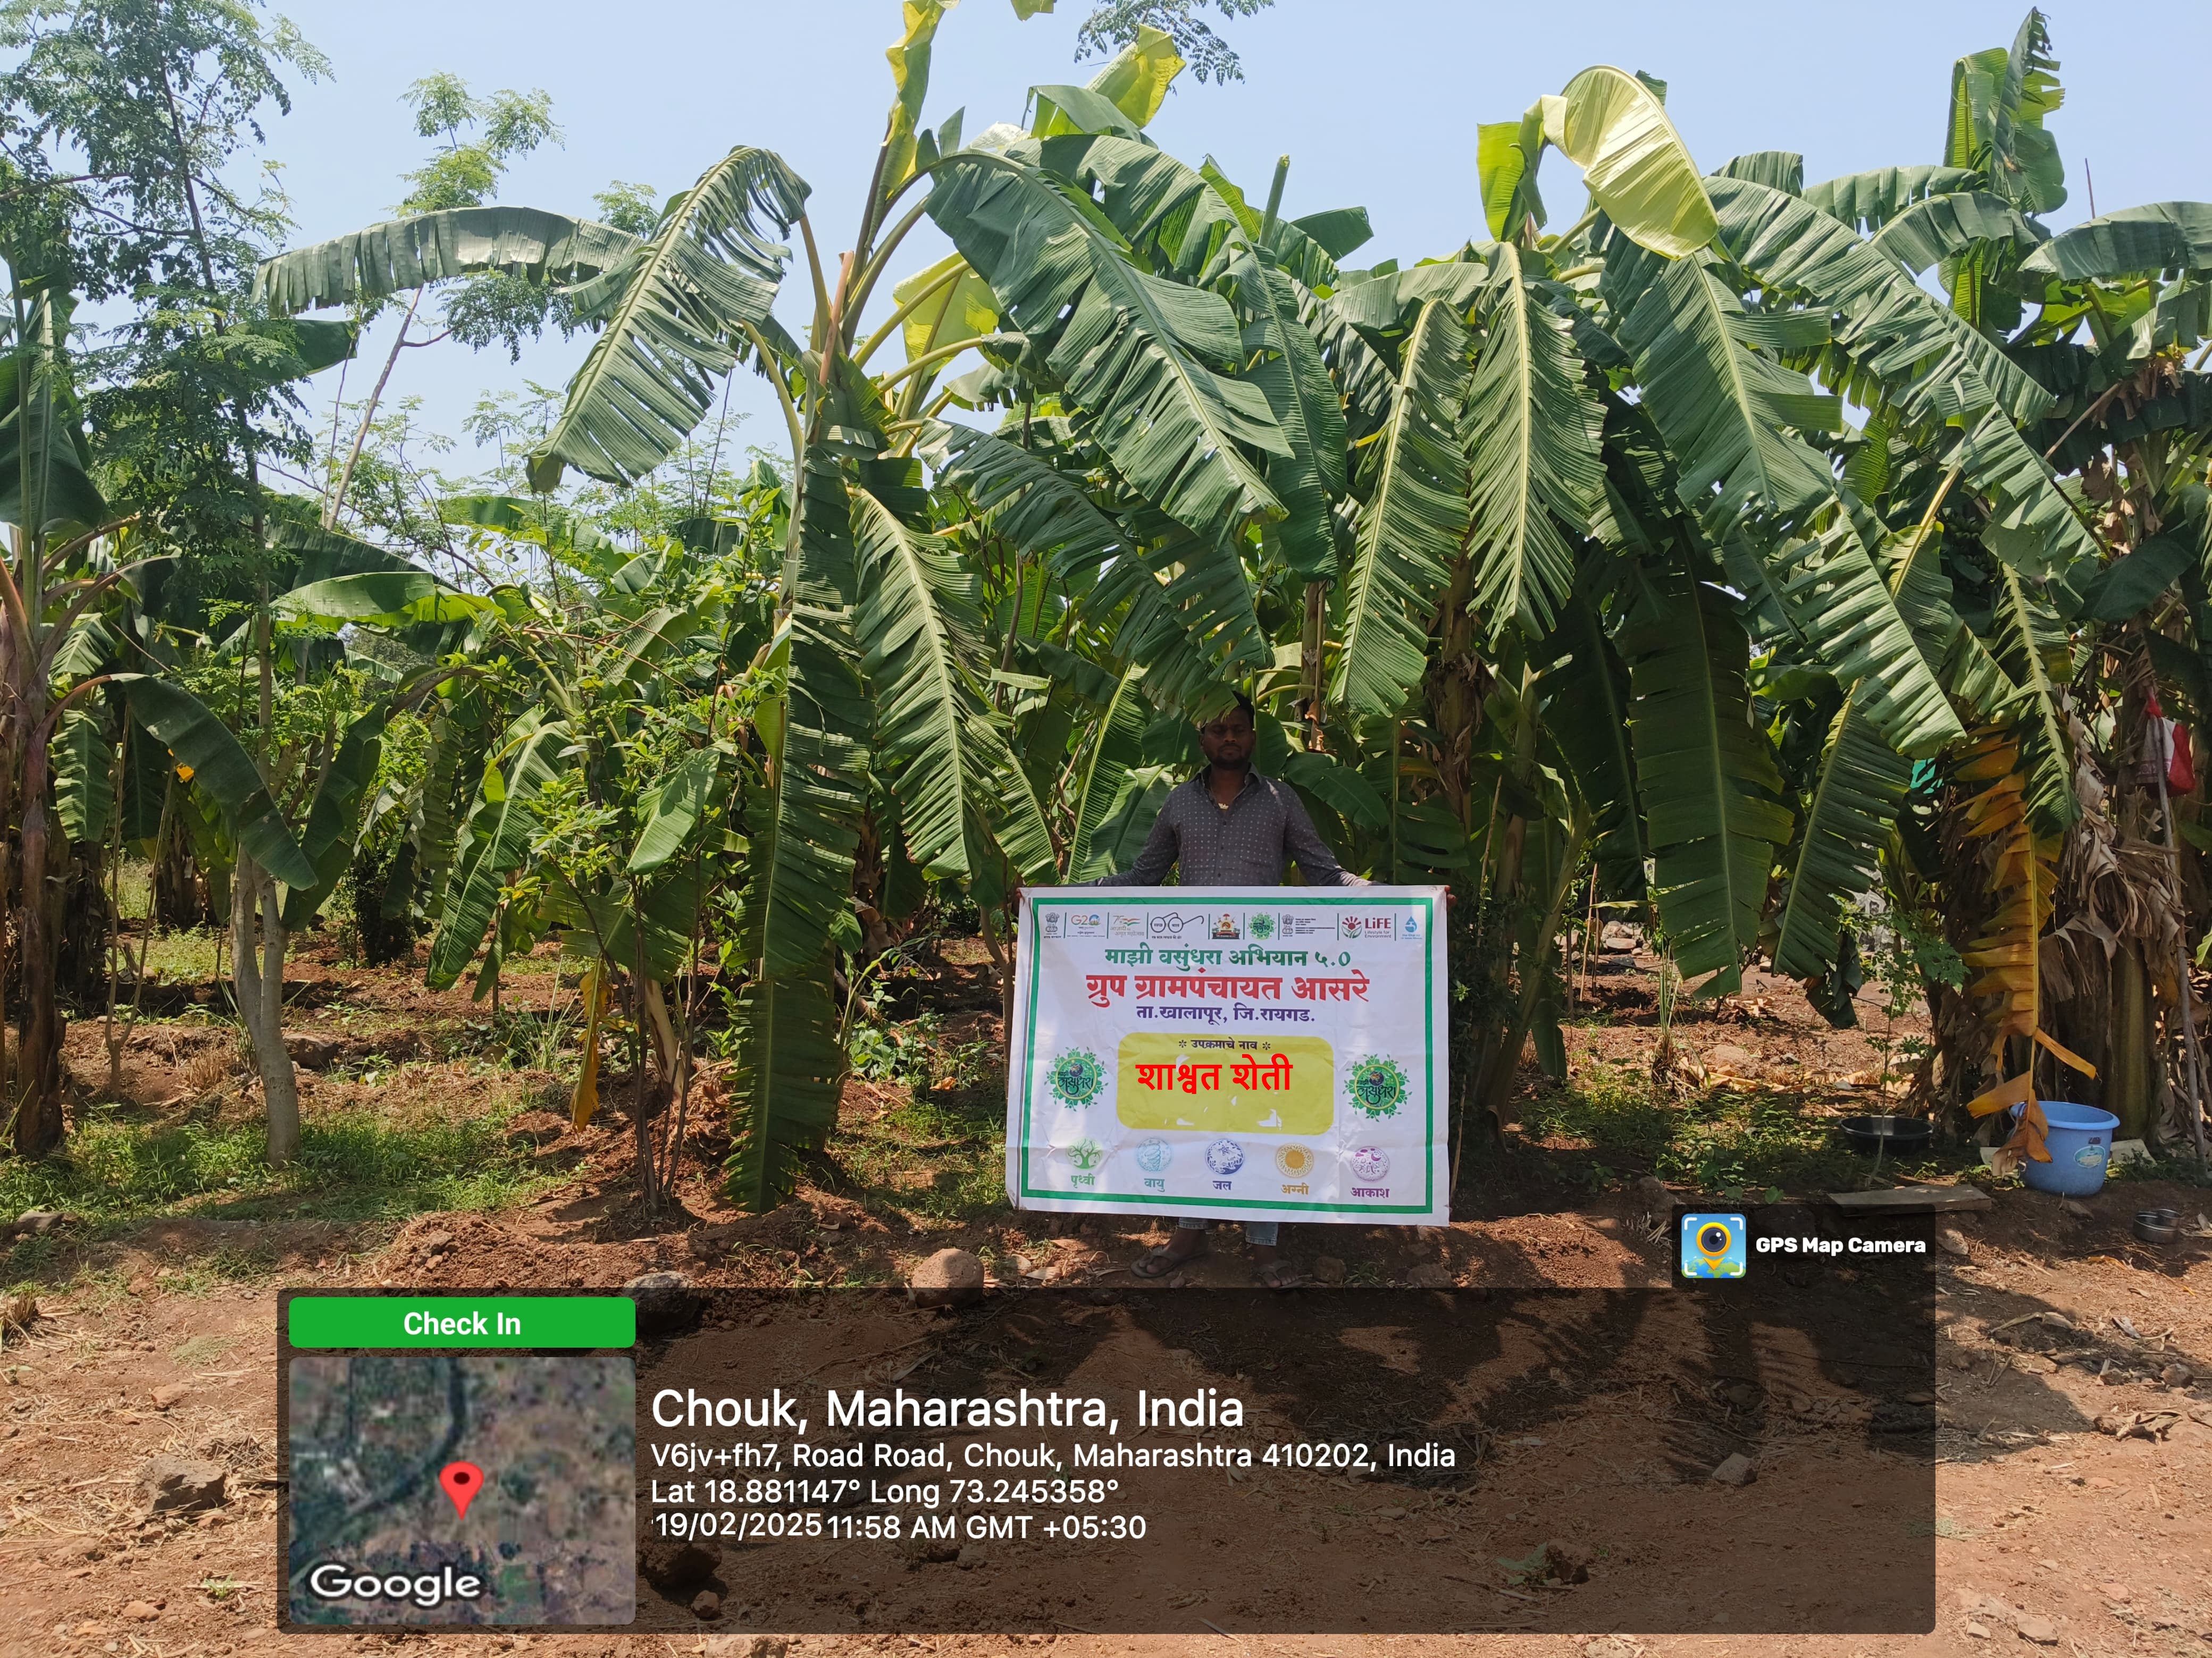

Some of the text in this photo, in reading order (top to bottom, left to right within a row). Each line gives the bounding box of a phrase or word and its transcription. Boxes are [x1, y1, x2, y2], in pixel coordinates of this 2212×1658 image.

[1365, 918, 1391, 929] LiFE
[1105, 942, 1153, 967] माझी
[1159, 943, 1222, 971] वसुंधरा
[1229, 944, 1308, 966] अभियान
[1086, 967, 1370, 1008] ग्रुप ग्रामपंचायत आसरे
[1233, 1002, 1315, 1022] जि.रायगड.
[1191, 1037, 1258, 1050] उपक्रमाचे नाव
[1071, 1173, 1095, 1188] पृथ्वी
[1144, 1177, 1165, 1192] वायु
[1212, 1180, 1232, 1190] जल
[1280, 1182, 1309, 1195] अग्नी
[1351, 1187, 1390, 1198] आकाश
